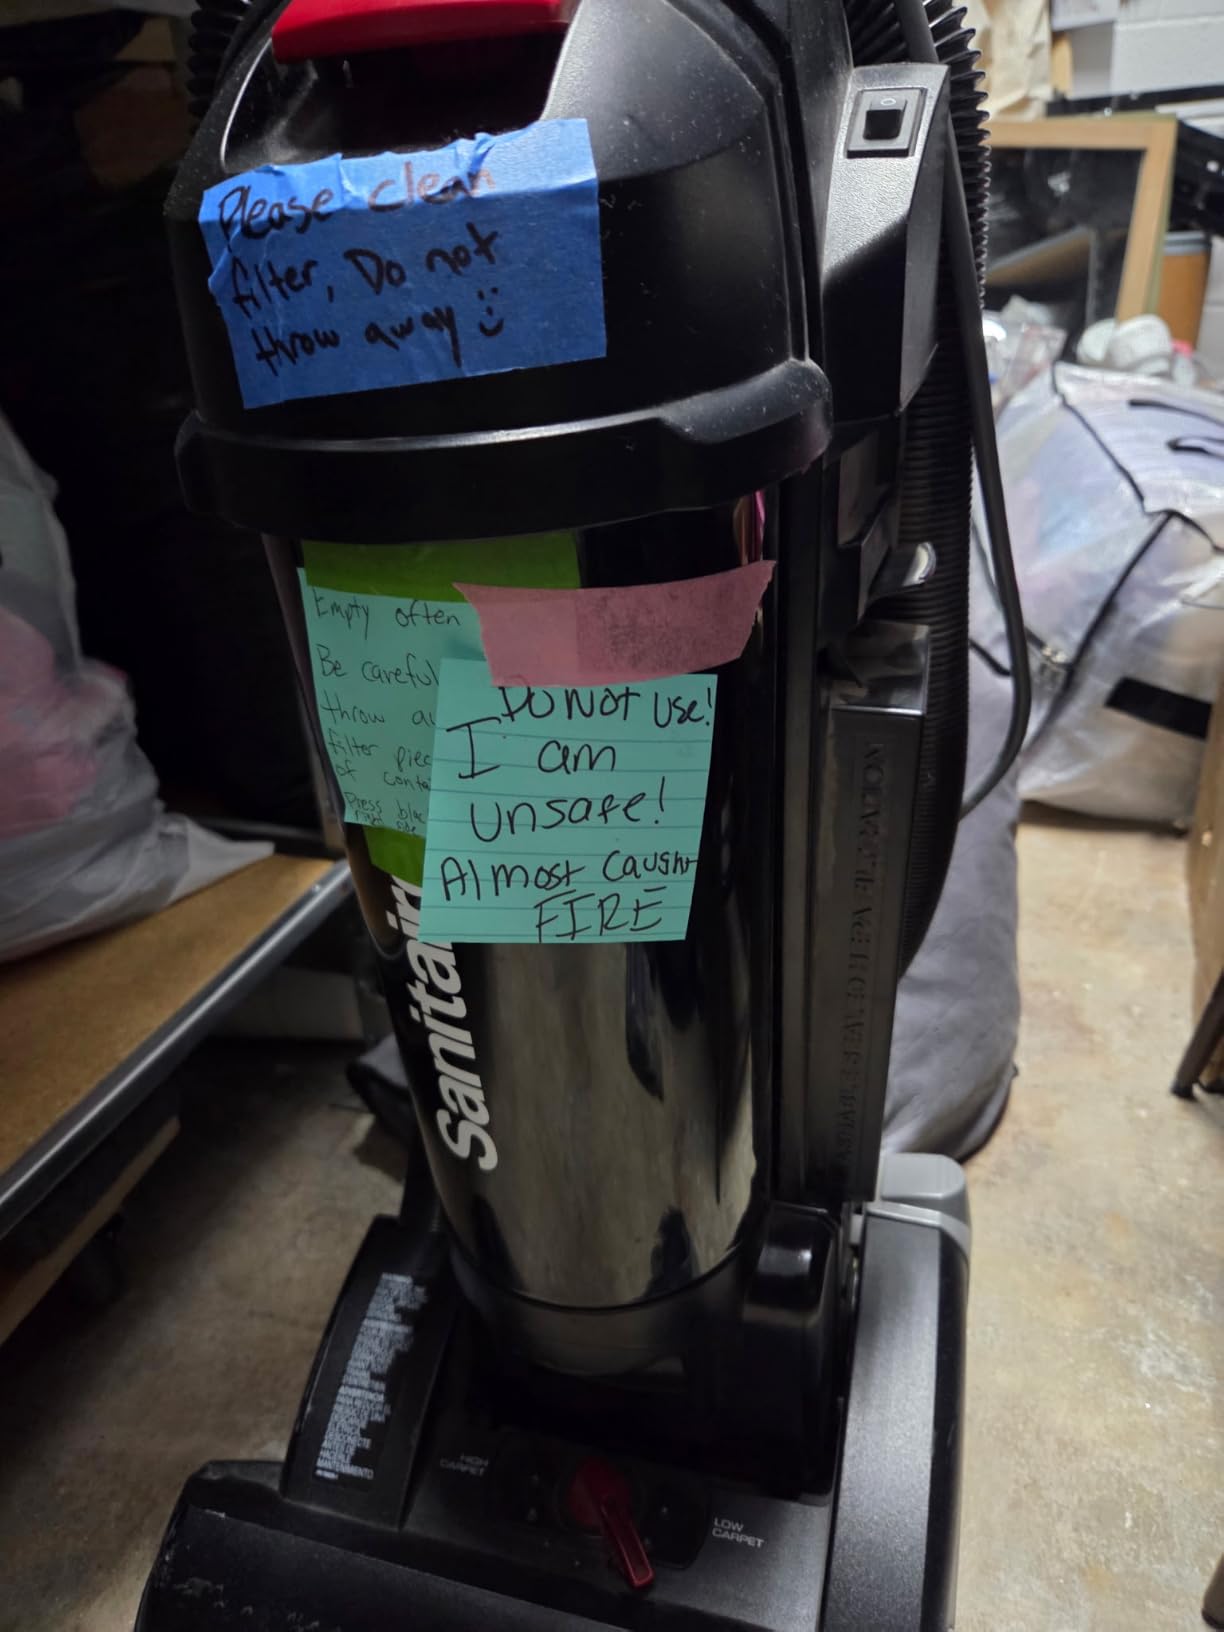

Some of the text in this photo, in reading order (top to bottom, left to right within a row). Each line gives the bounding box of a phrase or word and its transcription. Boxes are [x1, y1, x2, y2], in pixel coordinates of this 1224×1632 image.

[218, 161, 496, 251] Please clean
[344, 248, 406, 294] Do
[426, 221, 498, 276] not
[251, 305, 462, 376] throw away
[312, 588, 461, 640] Empty often
[316, 643, 348, 678] Be
[321, 690, 385, 725] throw
[446, 716, 617, 780] I am
[440, 856, 586, 901] Almost
[534, 886, 667, 943] FIRE
[386, 875, 498, 1171] sanitair
[711, 1528, 765, 1549] CARPET
[713, 1517, 745, 1532] LOW
